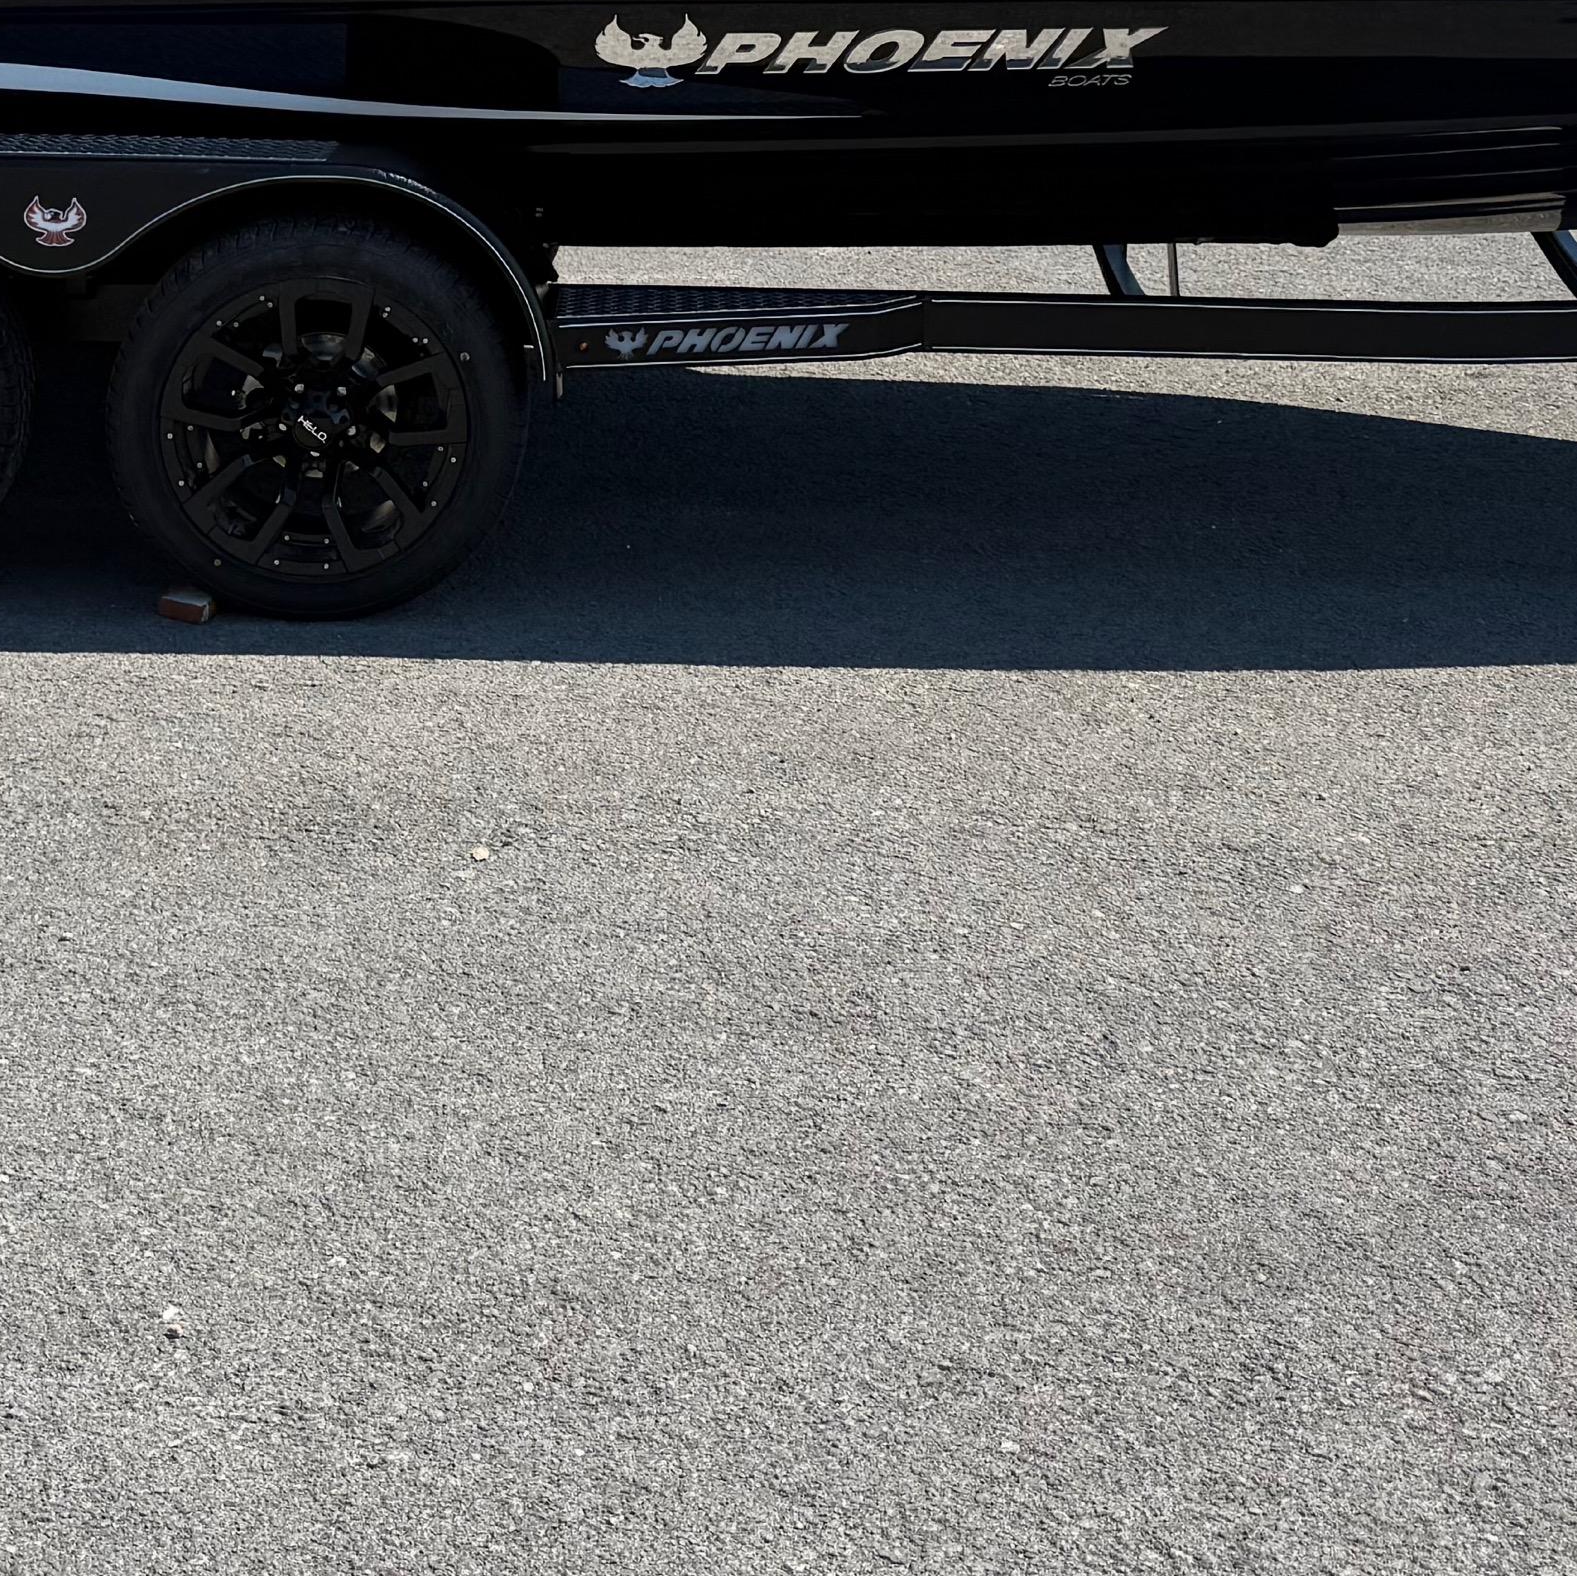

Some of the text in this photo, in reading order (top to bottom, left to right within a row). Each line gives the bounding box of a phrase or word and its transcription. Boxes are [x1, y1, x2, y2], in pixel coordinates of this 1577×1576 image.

[694, 26, 1169, 74] PHOENIX
[1048, 74, 1132, 87] BOATS
[646, 323, 850, 355] PHOENIX
